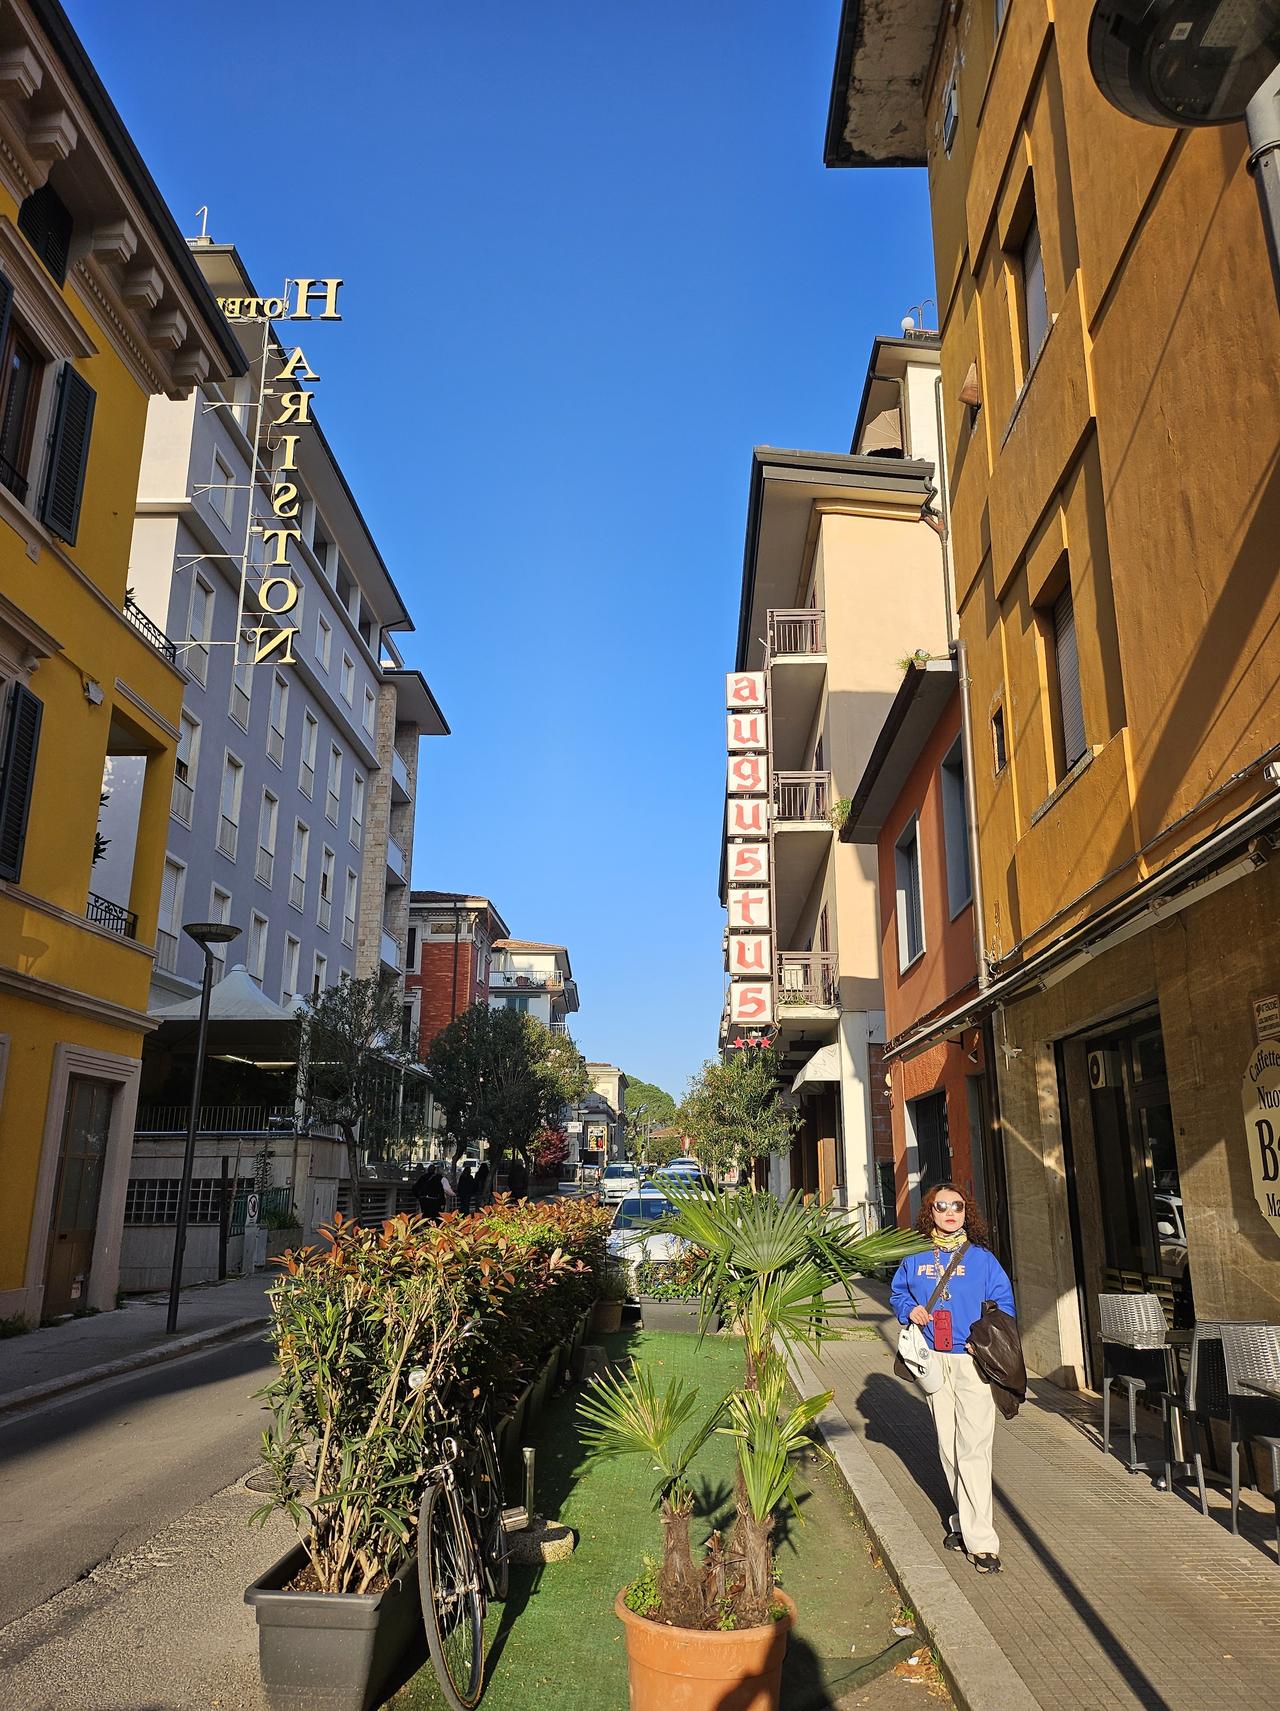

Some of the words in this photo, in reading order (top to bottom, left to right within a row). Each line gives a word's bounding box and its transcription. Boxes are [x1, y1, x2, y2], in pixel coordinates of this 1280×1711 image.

[732, 676, 768, 1019] augustus
[1257, 1086, 1280, 1110] Nuo
[1255, 1118, 1280, 1182] B
